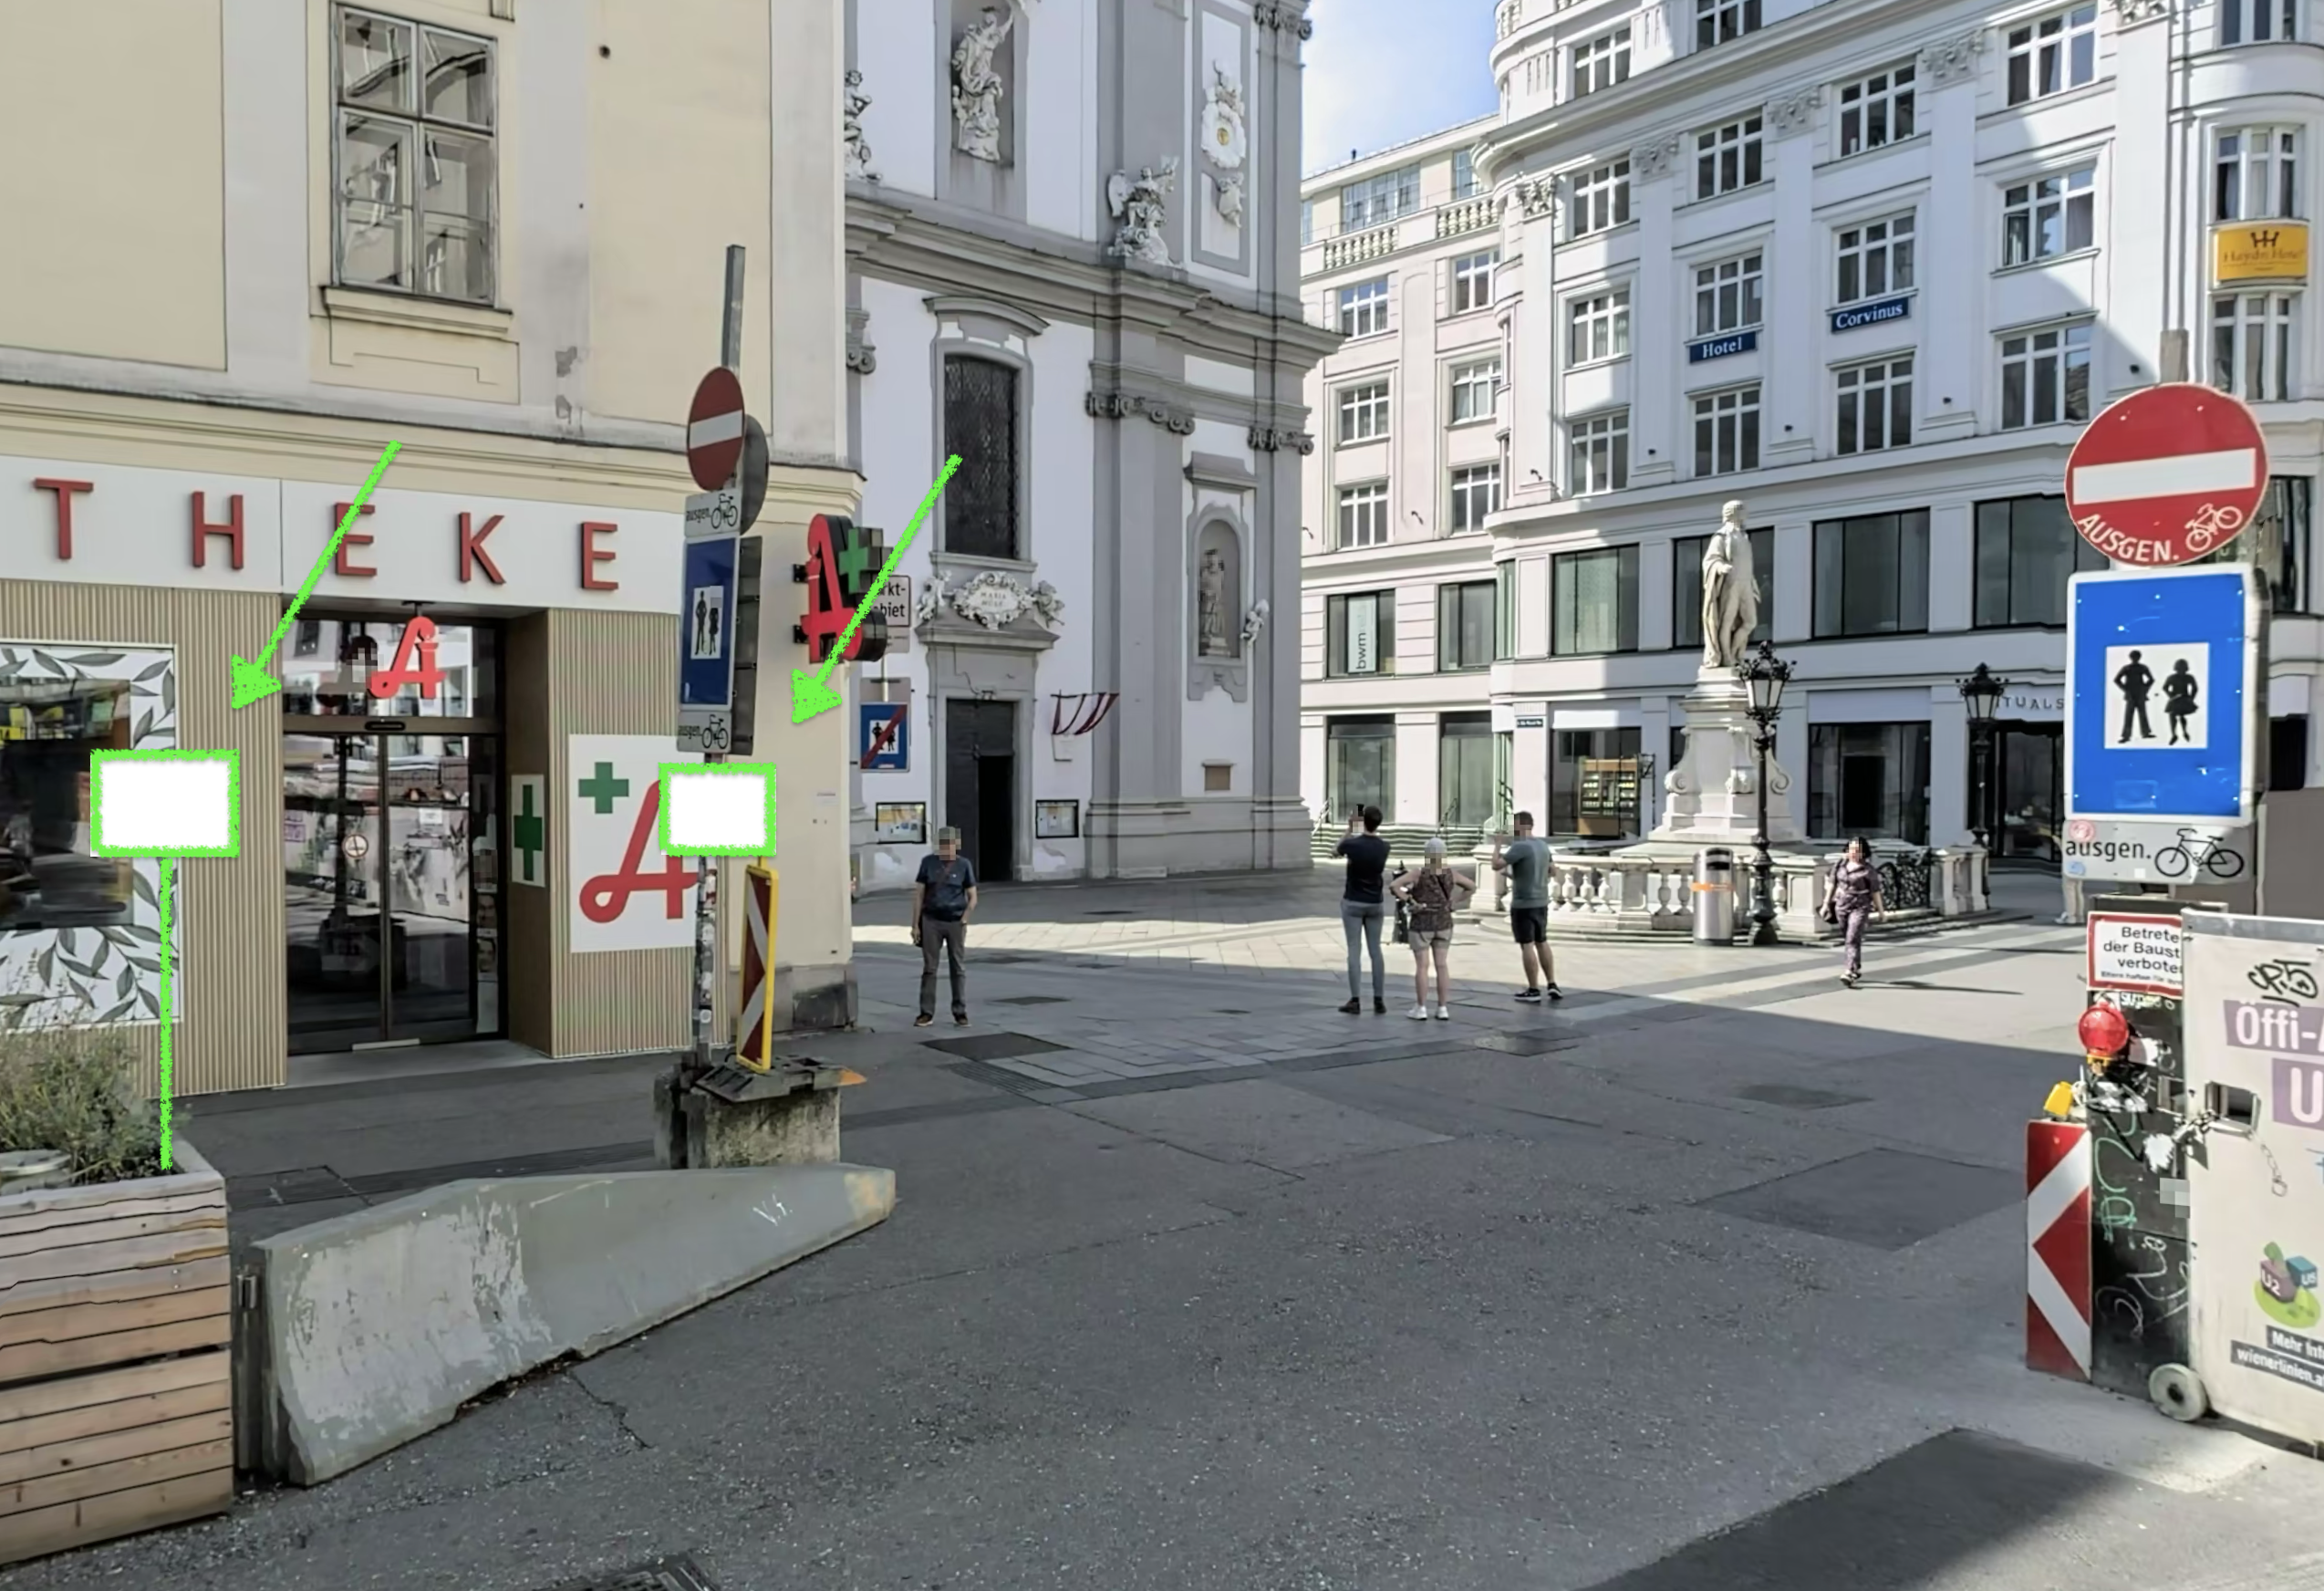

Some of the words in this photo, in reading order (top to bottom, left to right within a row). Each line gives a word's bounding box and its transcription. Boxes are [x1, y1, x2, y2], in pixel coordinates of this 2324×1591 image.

[1835, 304, 1904, 329] Corvinus
[1702, 337, 1742, 359] Hotel
[32, 477, 620, 591] THEKE
[2077, 514, 2180, 562] AUSGEN.
[1355, 632, 1367, 670] bwm
[2065, 840, 2152, 862] ausgen.
[2103, 941, 2129, 952] der
[2260, 1269, 2282, 1296] U2
[2272, 1330, 2303, 1354] Mehr
